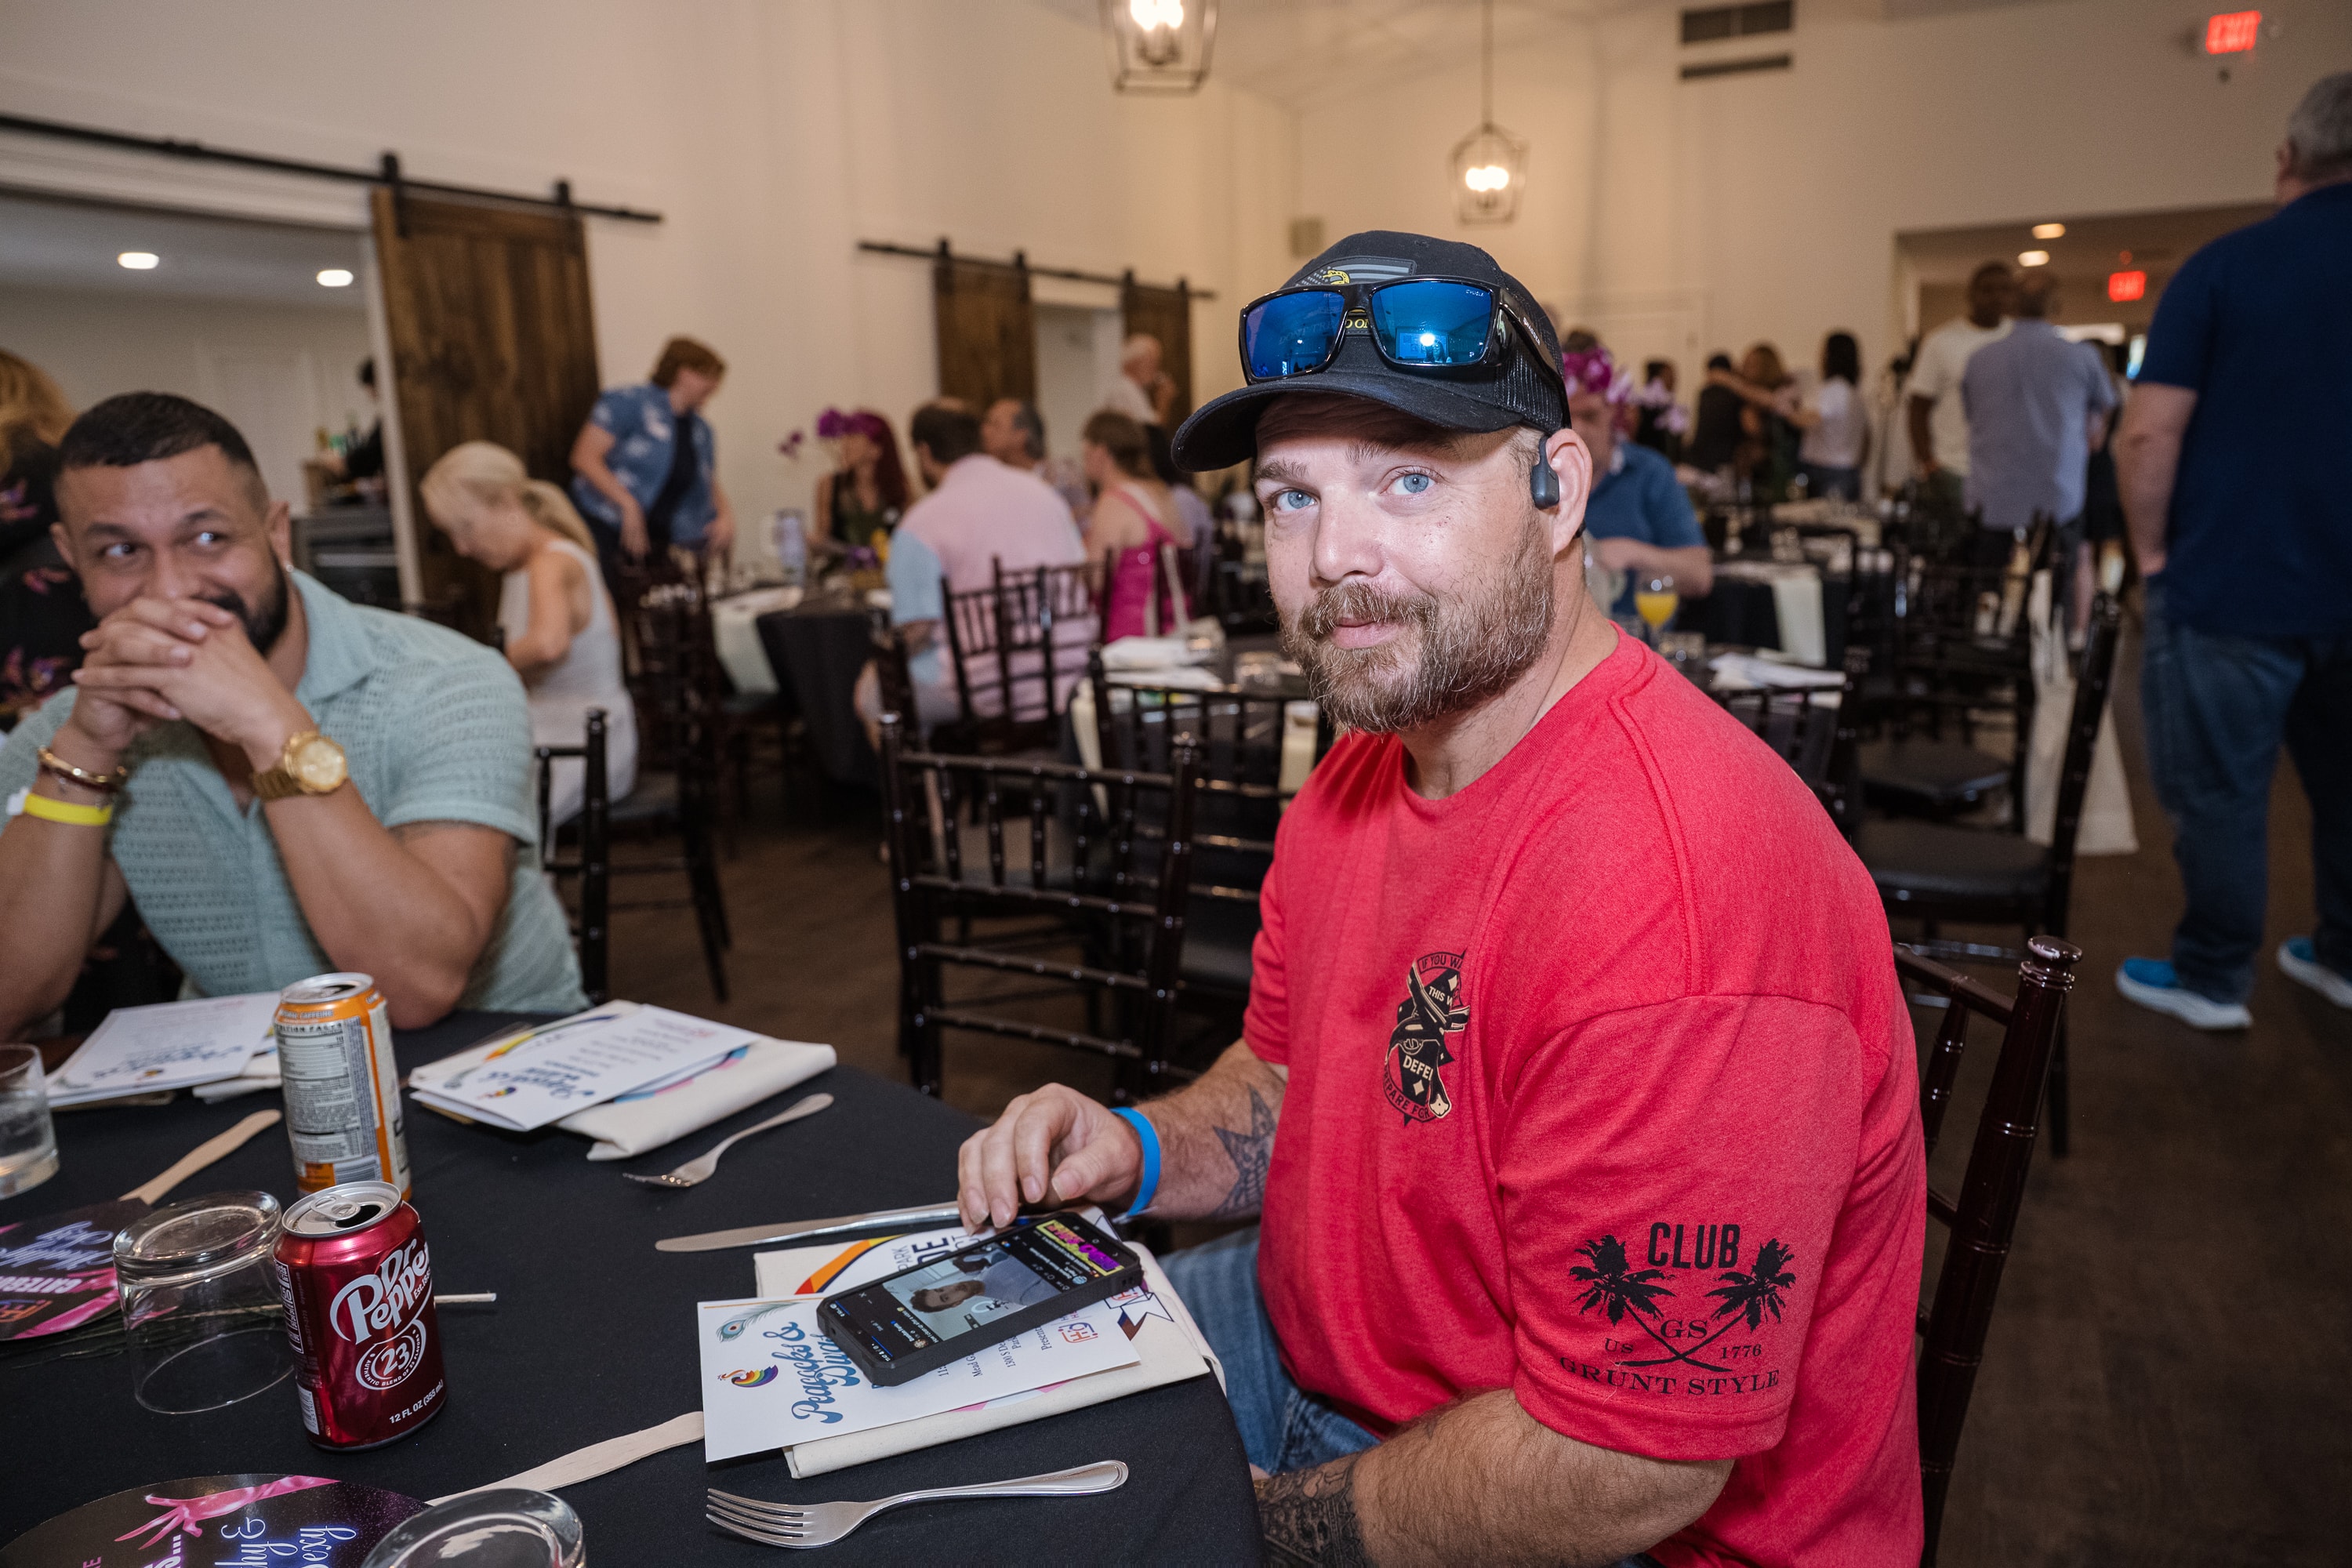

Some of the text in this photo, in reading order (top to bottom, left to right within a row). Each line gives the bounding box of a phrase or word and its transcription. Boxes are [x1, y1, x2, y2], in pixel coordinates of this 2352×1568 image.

[1421, 959, 1428, 970] IF
[1430, 954, 1447, 967] YOU
[1428, 985, 1446, 1002] THIS
[910, 1236, 952, 1265] DE
[1647, 1221, 1740, 1270] CLUB
[380, 1238, 417, 1297] Dr
[0, 1275, 82, 1294] CATEG
[1660, 1319, 1708, 1340] GS
[380, 1342, 410, 1377] 23
[1003, 1356, 1016, 1368] 1300
[1604, 1338, 1762, 1360] US 1776
[363, 1359, 380, 1386] AUTHENTIC
[381, 1375, 402, 1386] BLEND
[763, 1321, 844, 1425] Peacocks &
[971, 1359, 983, 1377] Mead
[1559, 1356, 1780, 1396] GRUNT STYLE
[389, 1414, 401, 1424] 12
[401, 1407, 412, 1418] FL
[412, 1399, 423, 1412] OZ
[423, 1389, 437, 1406] (355
[220, 1516, 267, 1541] &
[299, 1526, 357, 1568] exy
